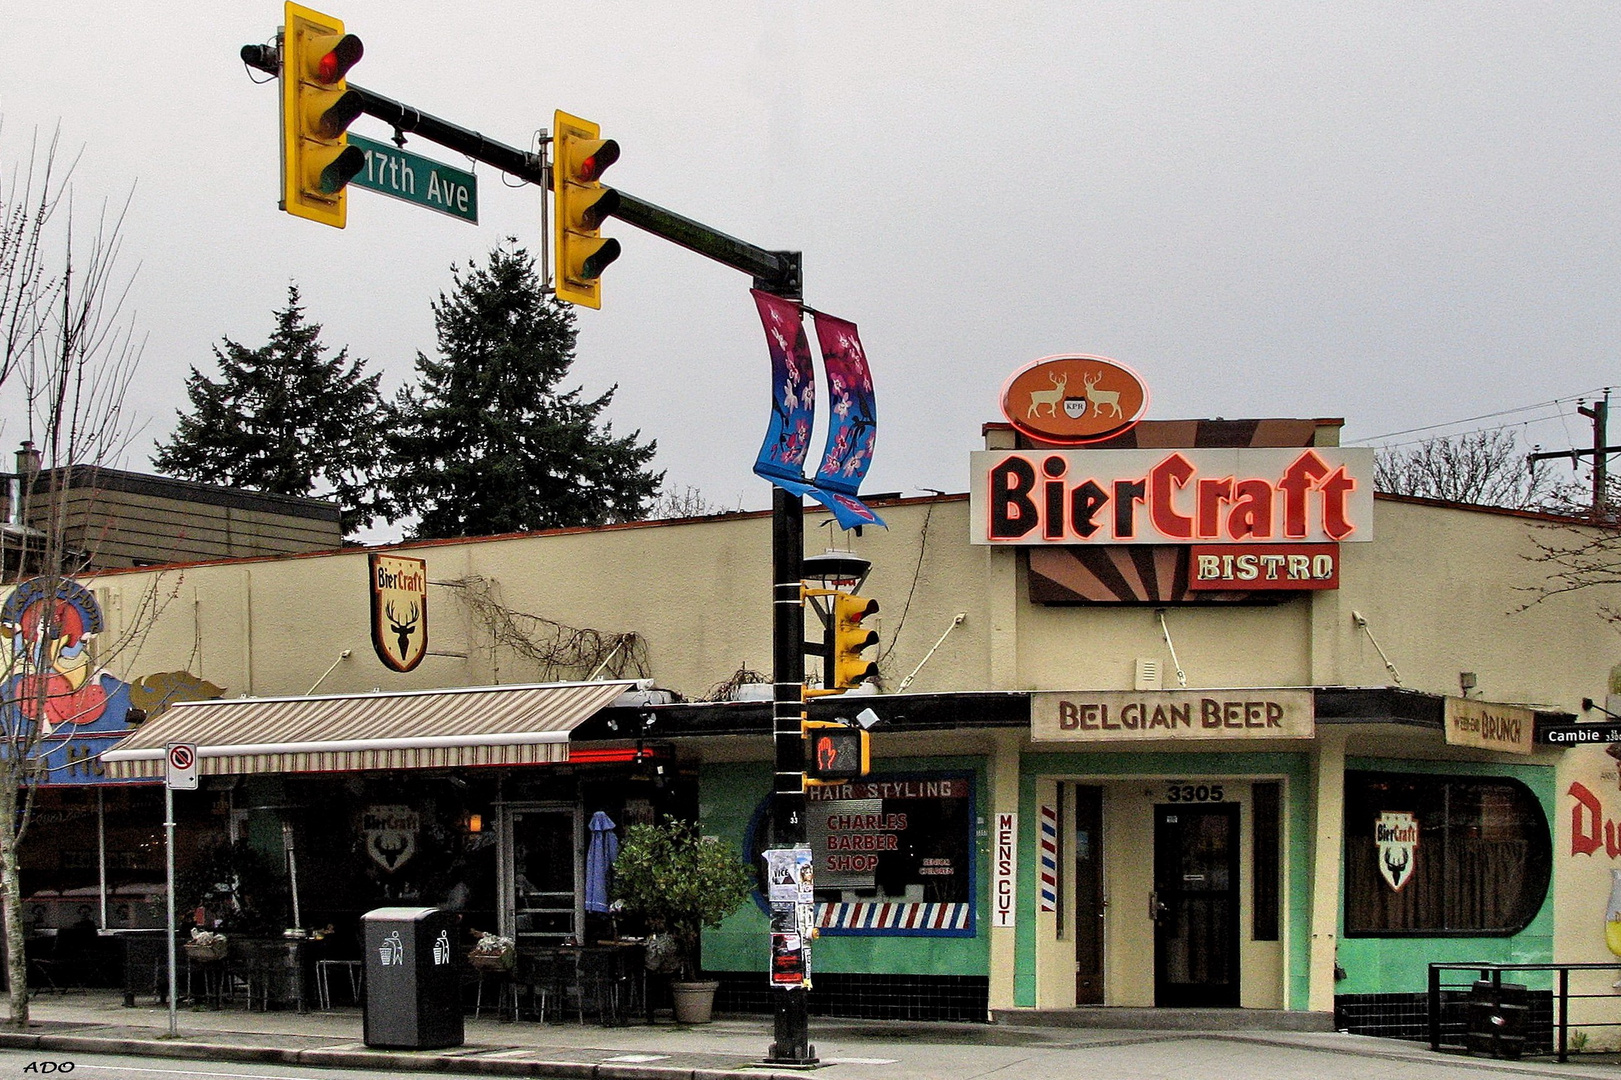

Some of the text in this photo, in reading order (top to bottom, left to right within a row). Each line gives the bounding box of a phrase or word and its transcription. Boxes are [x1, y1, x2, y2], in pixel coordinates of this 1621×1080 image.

[364, 150, 470, 212] 17th Ave
[987, 449, 1358, 542] BierCraft
[1197, 554, 1333, 581] BISTRO
[377, 567, 423, 592] BierCraft
[1059, 698, 1284, 731] BELGIAN BEER
[1482, 711, 1521, 743] BRUNCH
[1548, 730, 1600, 742] Cambie
[810, 782, 952, 800] HAIR STYLING
[1167, 785, 1223, 802] 3305
[827, 813, 908, 831] CHARLES
[1377, 823, 1416, 842] BierCraft
[827, 834, 898, 851] BARBER
[827, 855, 879, 872] SHOP
[998, 814, 1012, 925] MENS CUT
